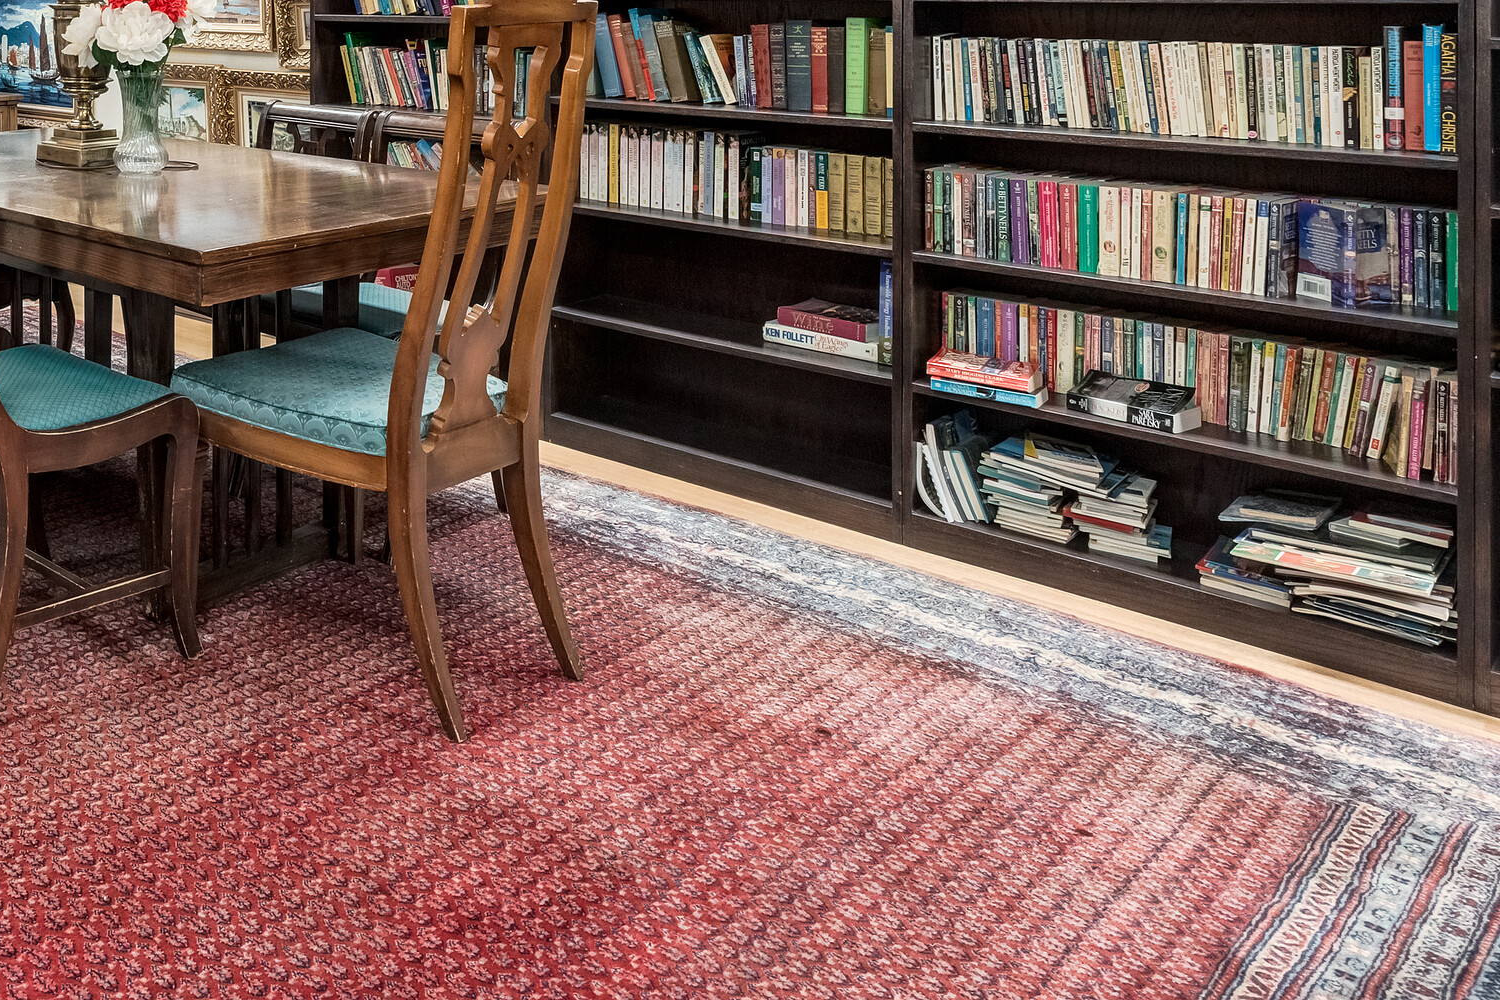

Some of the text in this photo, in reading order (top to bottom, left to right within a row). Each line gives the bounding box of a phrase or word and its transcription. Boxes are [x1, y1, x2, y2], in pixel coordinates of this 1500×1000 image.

[1388, 29, 1399, 61] AGATHA
[1373, 49, 1381, 66] PATRICIA
[1441, 34, 1456, 75] AGATHA
[1389, 62, 1400, 97] CHRISTIE
[1442, 111, 1456, 152] CHRISTIE
[998, 191, 1007, 239] BETTY NEELS
[793, 313, 834, 332] Wine
[765, 328, 815, 344] KEN FOLLETT
[814, 334, 849, 350] On Wings
[821, 343, 847, 353] Eagles
[954, 374, 984, 383] REMEMBER
[1131, 414, 1160, 428] PARETSKY
[1139, 410, 1154, 419] SARA
